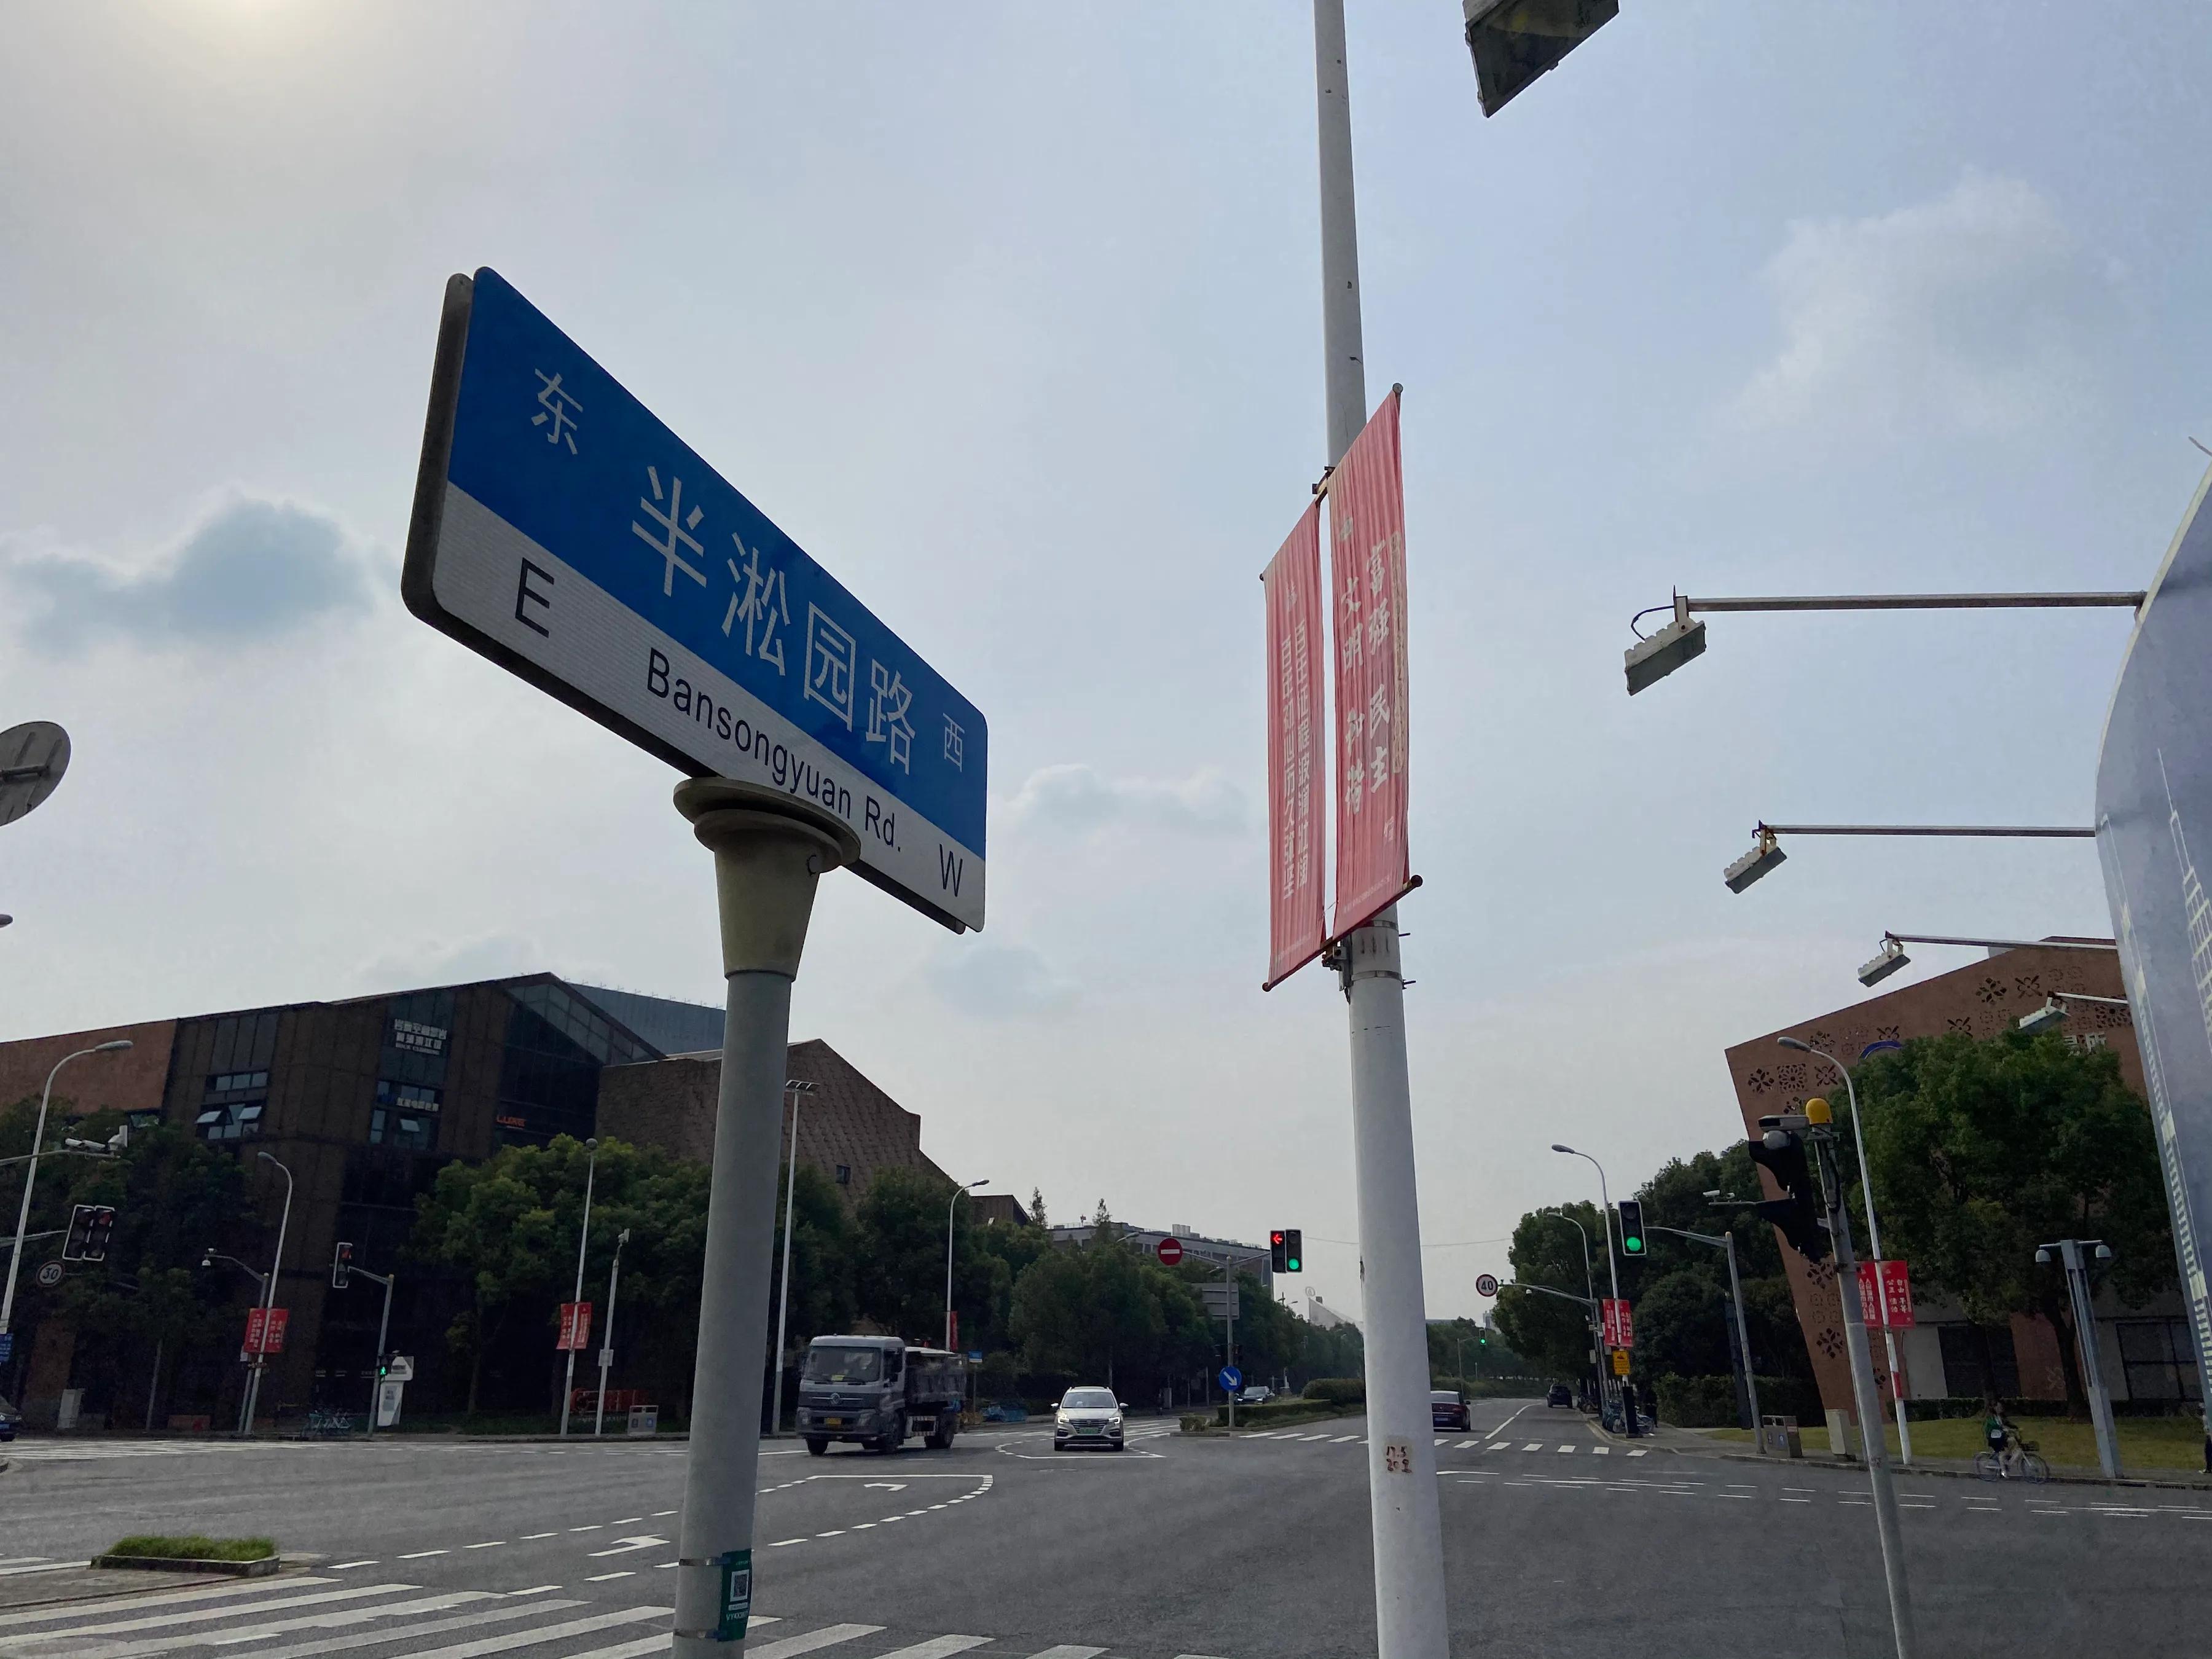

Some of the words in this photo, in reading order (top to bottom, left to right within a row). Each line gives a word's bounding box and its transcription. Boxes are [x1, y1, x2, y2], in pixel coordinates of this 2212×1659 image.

[529, 367, 584, 455] 东
[514, 557, 555, 638] E
[631, 465, 916, 775] 半淞园路
[646, 647, 852, 820] Bansongyuan
[864, 794, 901, 852] Rd.
[941, 712, 963, 773] 西
[1370, 683, 1390, 793] 民主
[938, 842, 963, 898] W
[42, 1268, 59, 1280] 30
[1481, 1281, 1493, 1290] 40
